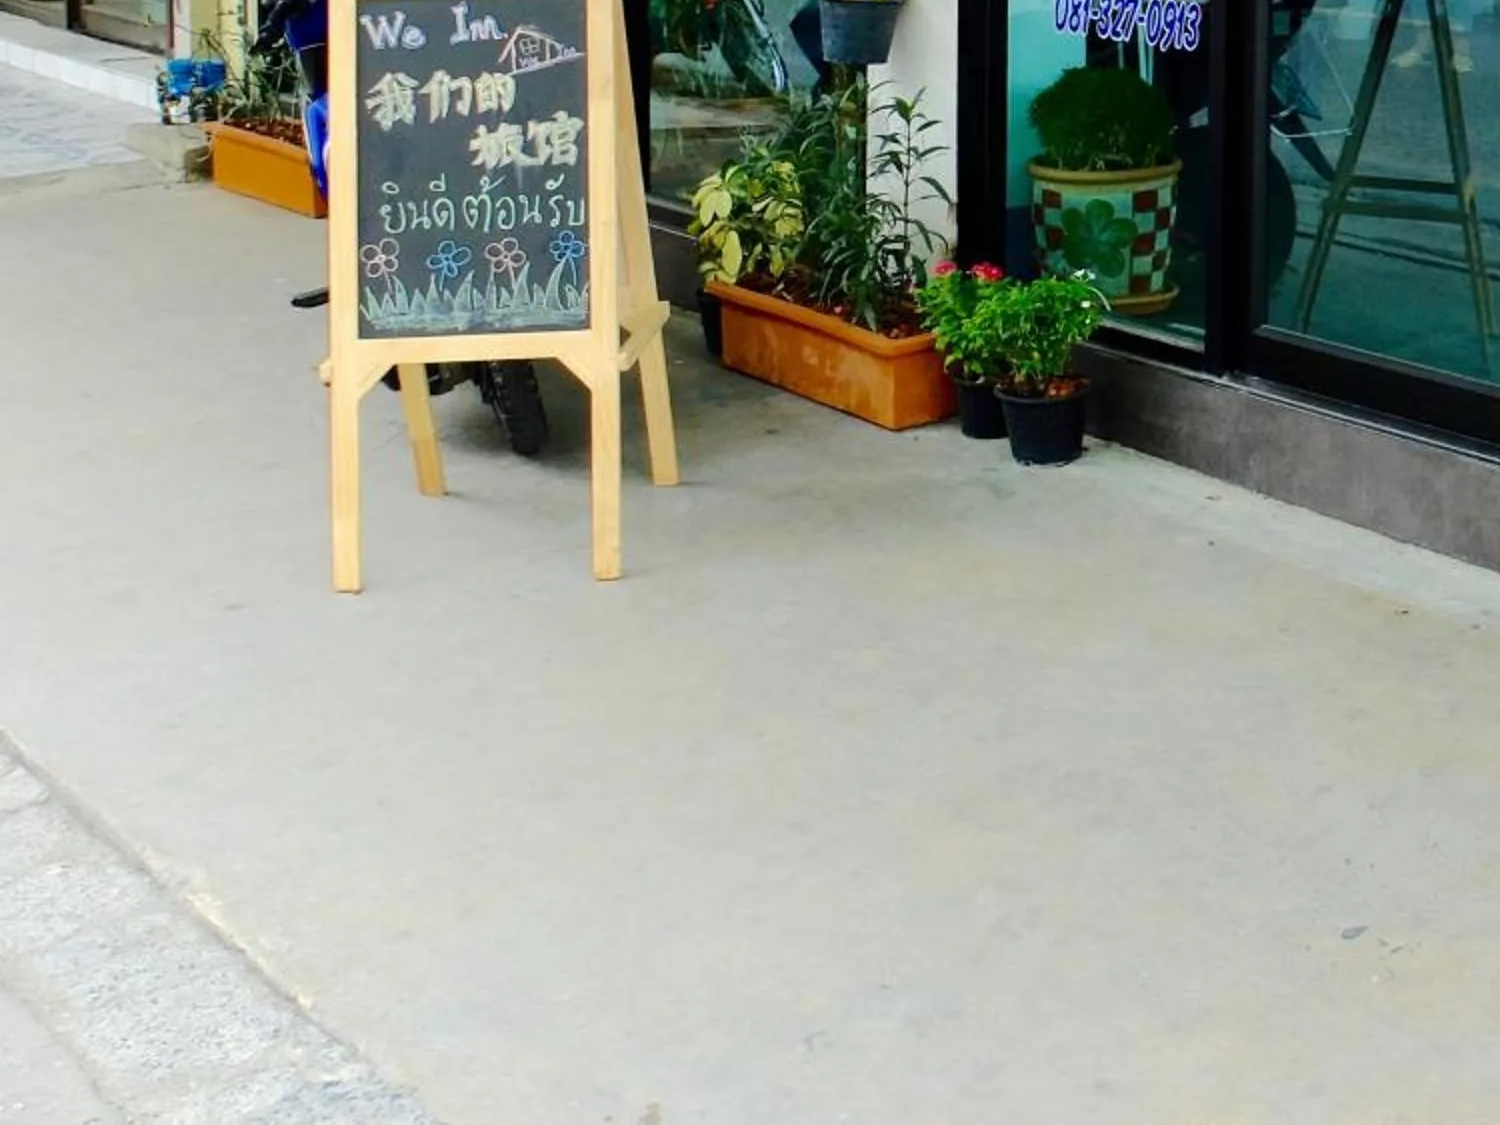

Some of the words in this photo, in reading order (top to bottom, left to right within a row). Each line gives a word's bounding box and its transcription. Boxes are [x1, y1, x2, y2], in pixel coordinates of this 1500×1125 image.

[360, 11, 426, 50] We
[365, 70, 517, 131] 我们的
